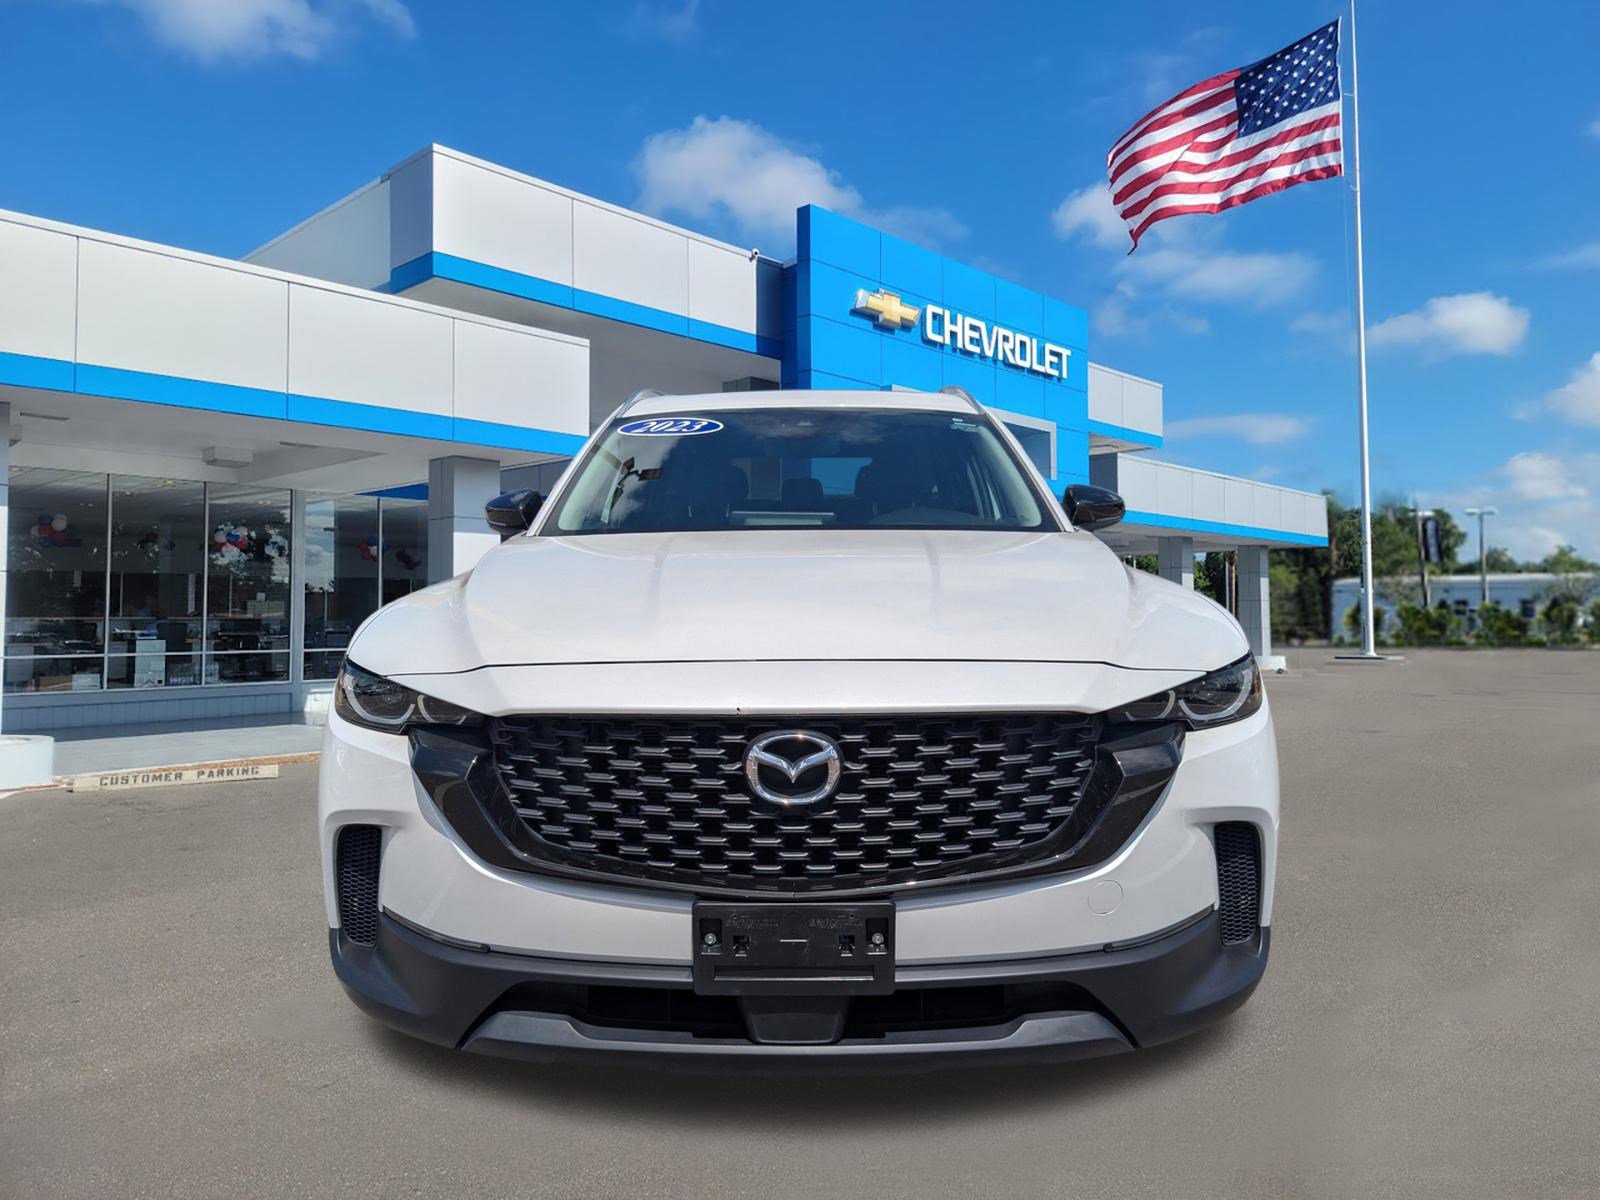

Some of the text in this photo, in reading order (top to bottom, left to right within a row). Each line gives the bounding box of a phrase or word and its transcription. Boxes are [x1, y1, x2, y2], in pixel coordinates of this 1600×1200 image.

[924, 304, 1072, 378] CHEVROLET
[630, 420, 709, 433] 2023
[99, 766, 260, 787] CUSTOMER PARKING
